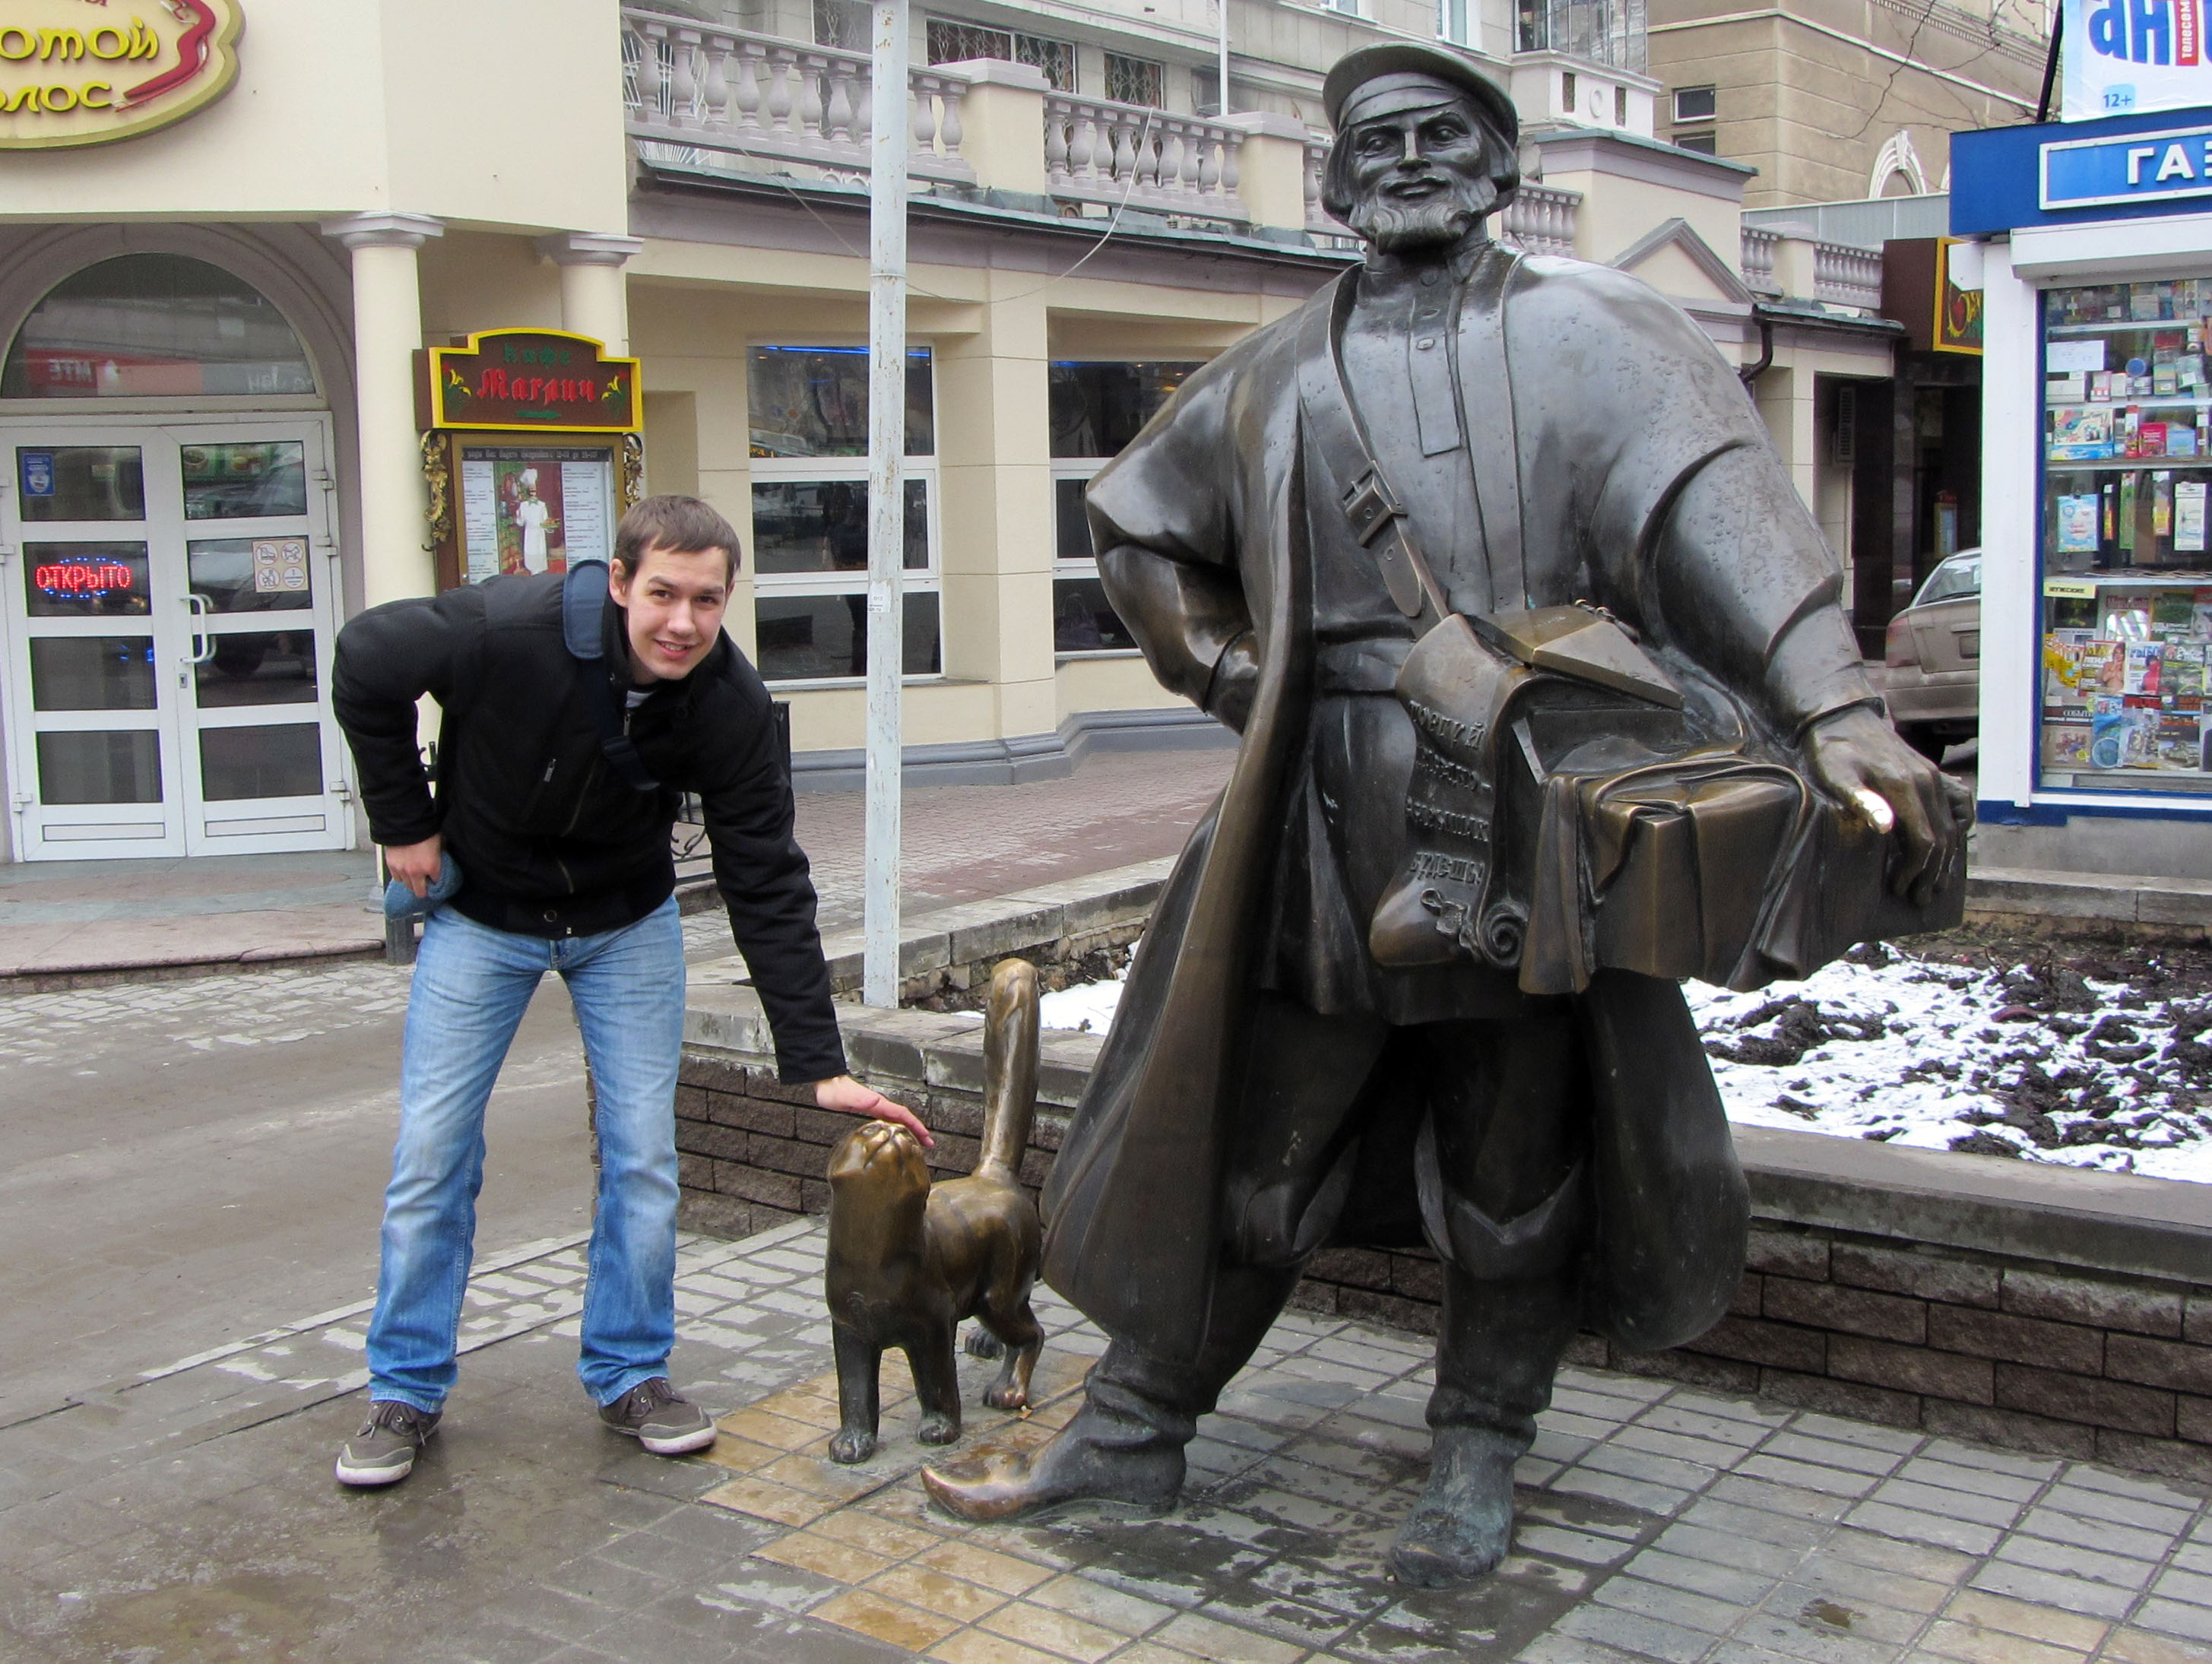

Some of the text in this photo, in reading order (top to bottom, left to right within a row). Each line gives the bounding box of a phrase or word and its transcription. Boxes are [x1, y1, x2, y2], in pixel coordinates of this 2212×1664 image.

[0, 81, 112, 113] лос
[2103, 94, 2131, 108] 12+
[36, 566, 132, 592] ОТКРЫТО
